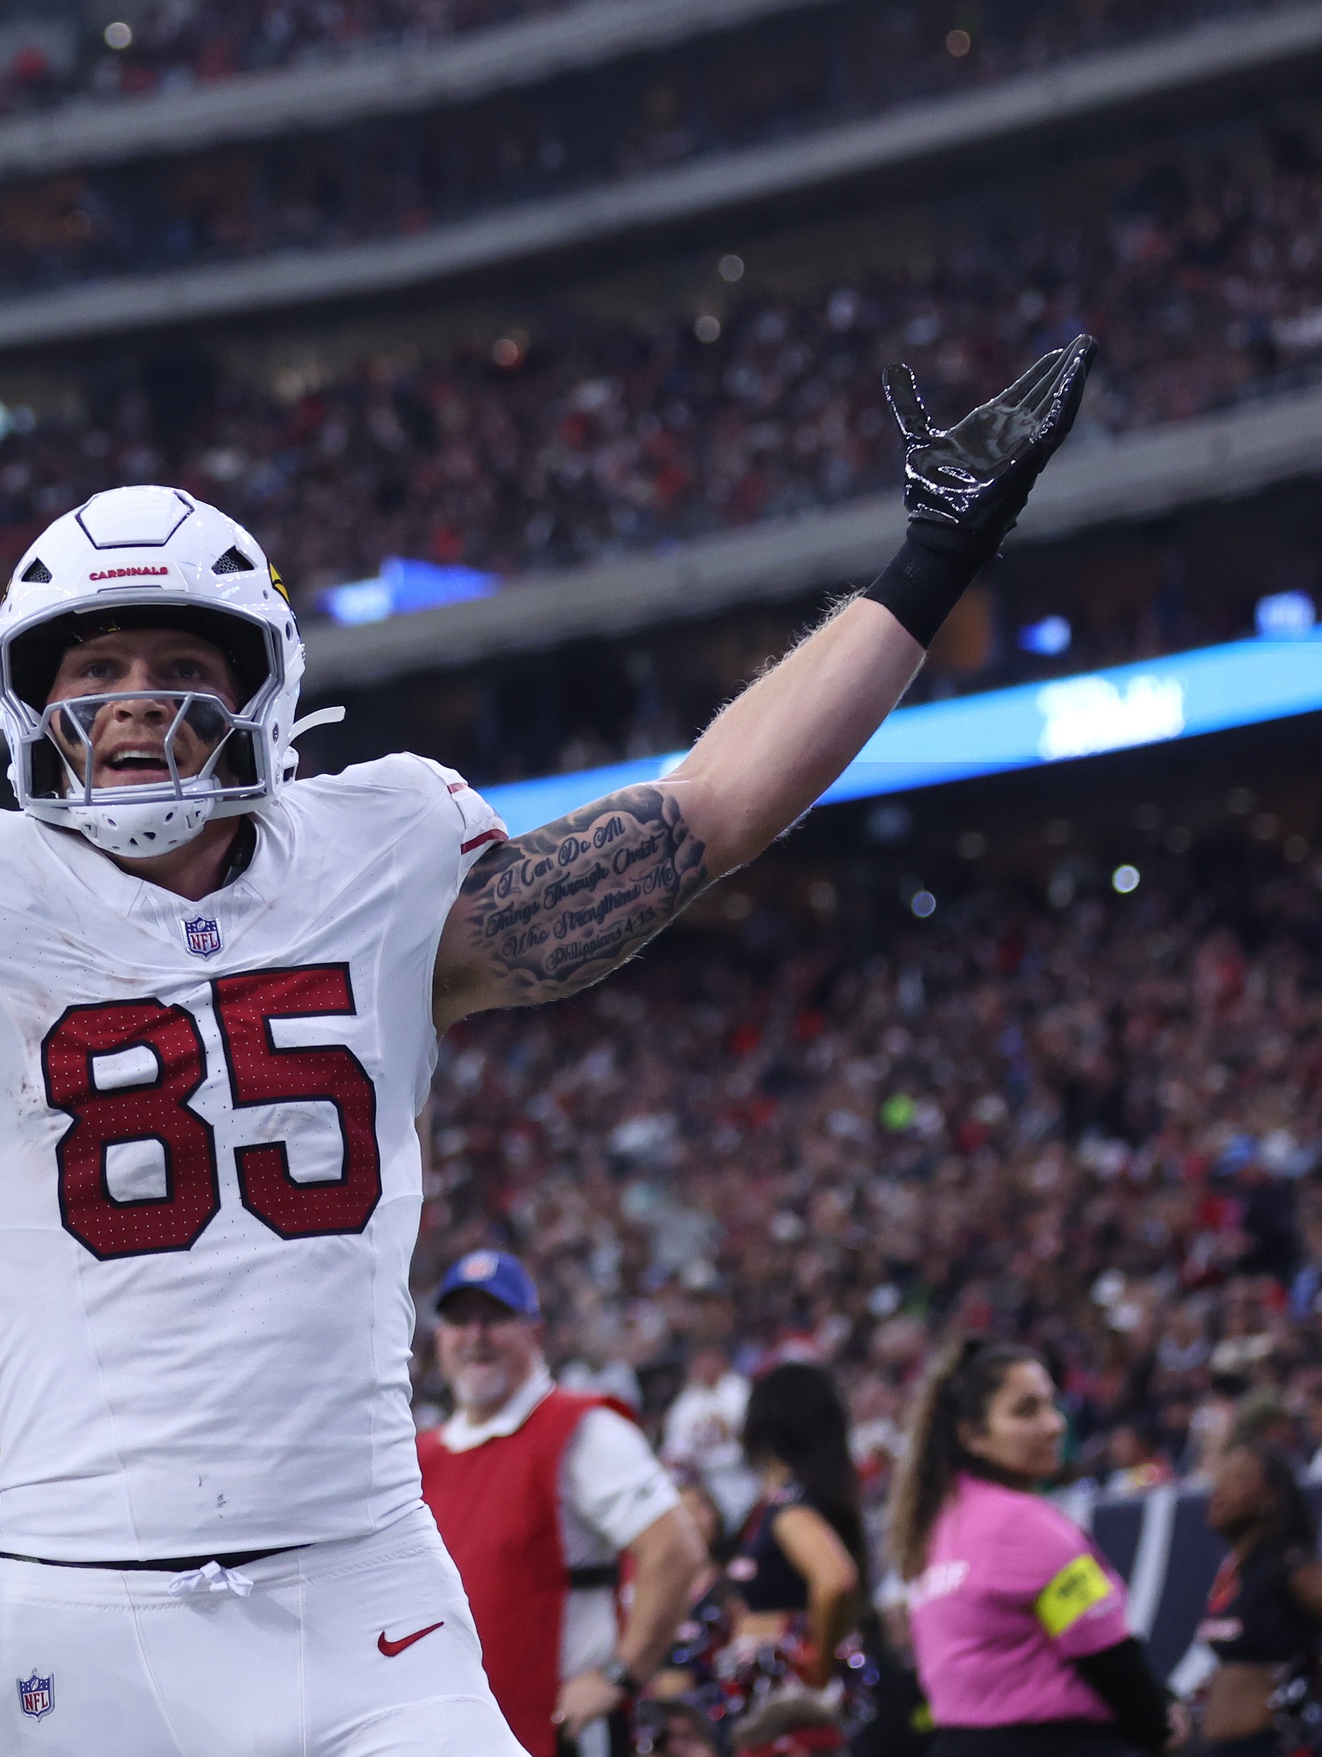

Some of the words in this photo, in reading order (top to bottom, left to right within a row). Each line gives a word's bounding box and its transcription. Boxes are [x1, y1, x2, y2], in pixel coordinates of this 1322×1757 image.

[89, 567, 168, 581] CARDINALS
[485, 902, 541, 937] Things
[544, 862, 609, 909] Through
[613, 829, 668, 875] Christ
[521, 858, 554, 887] Can
[558, 836, 591, 867] Do
[593, 816, 625, 849] All
[190, 933, 218, 951] NFL
[503, 923, 549, 957] Who
[633, 862, 677, 895] Me
[40, 961, 383, 1262] 85
[24, 1692, 48, 1712] NFL
